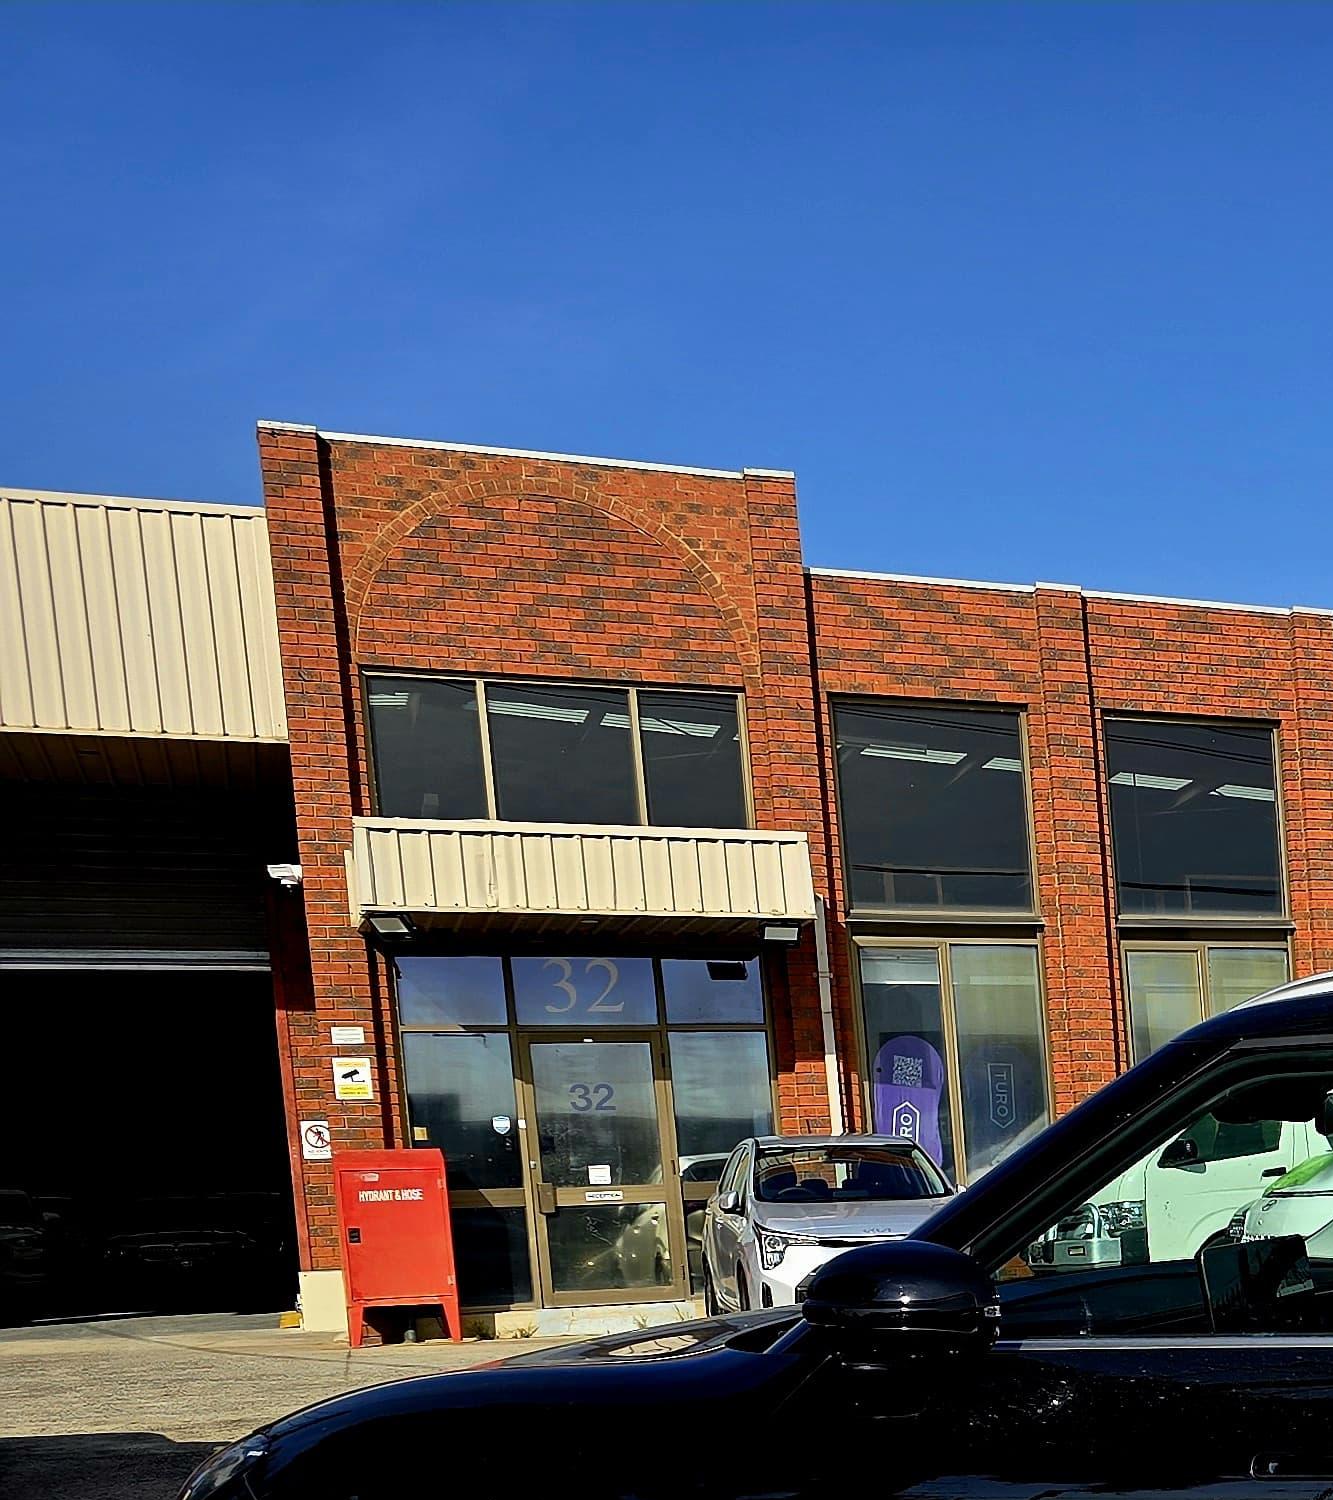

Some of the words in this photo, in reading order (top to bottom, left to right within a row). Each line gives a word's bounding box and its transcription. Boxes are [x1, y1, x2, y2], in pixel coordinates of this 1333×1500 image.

[543, 958, 625, 1013] 32
[569, 1083, 617, 1112] 32
[994, 1071, 1009, 1117] TURO
[900, 1113, 913, 1138] RO
[358, 1189, 394, 1202] HYDRANT
[395, 1189, 401, 1201] &
[401, 1188, 424, 1201] HOSE
